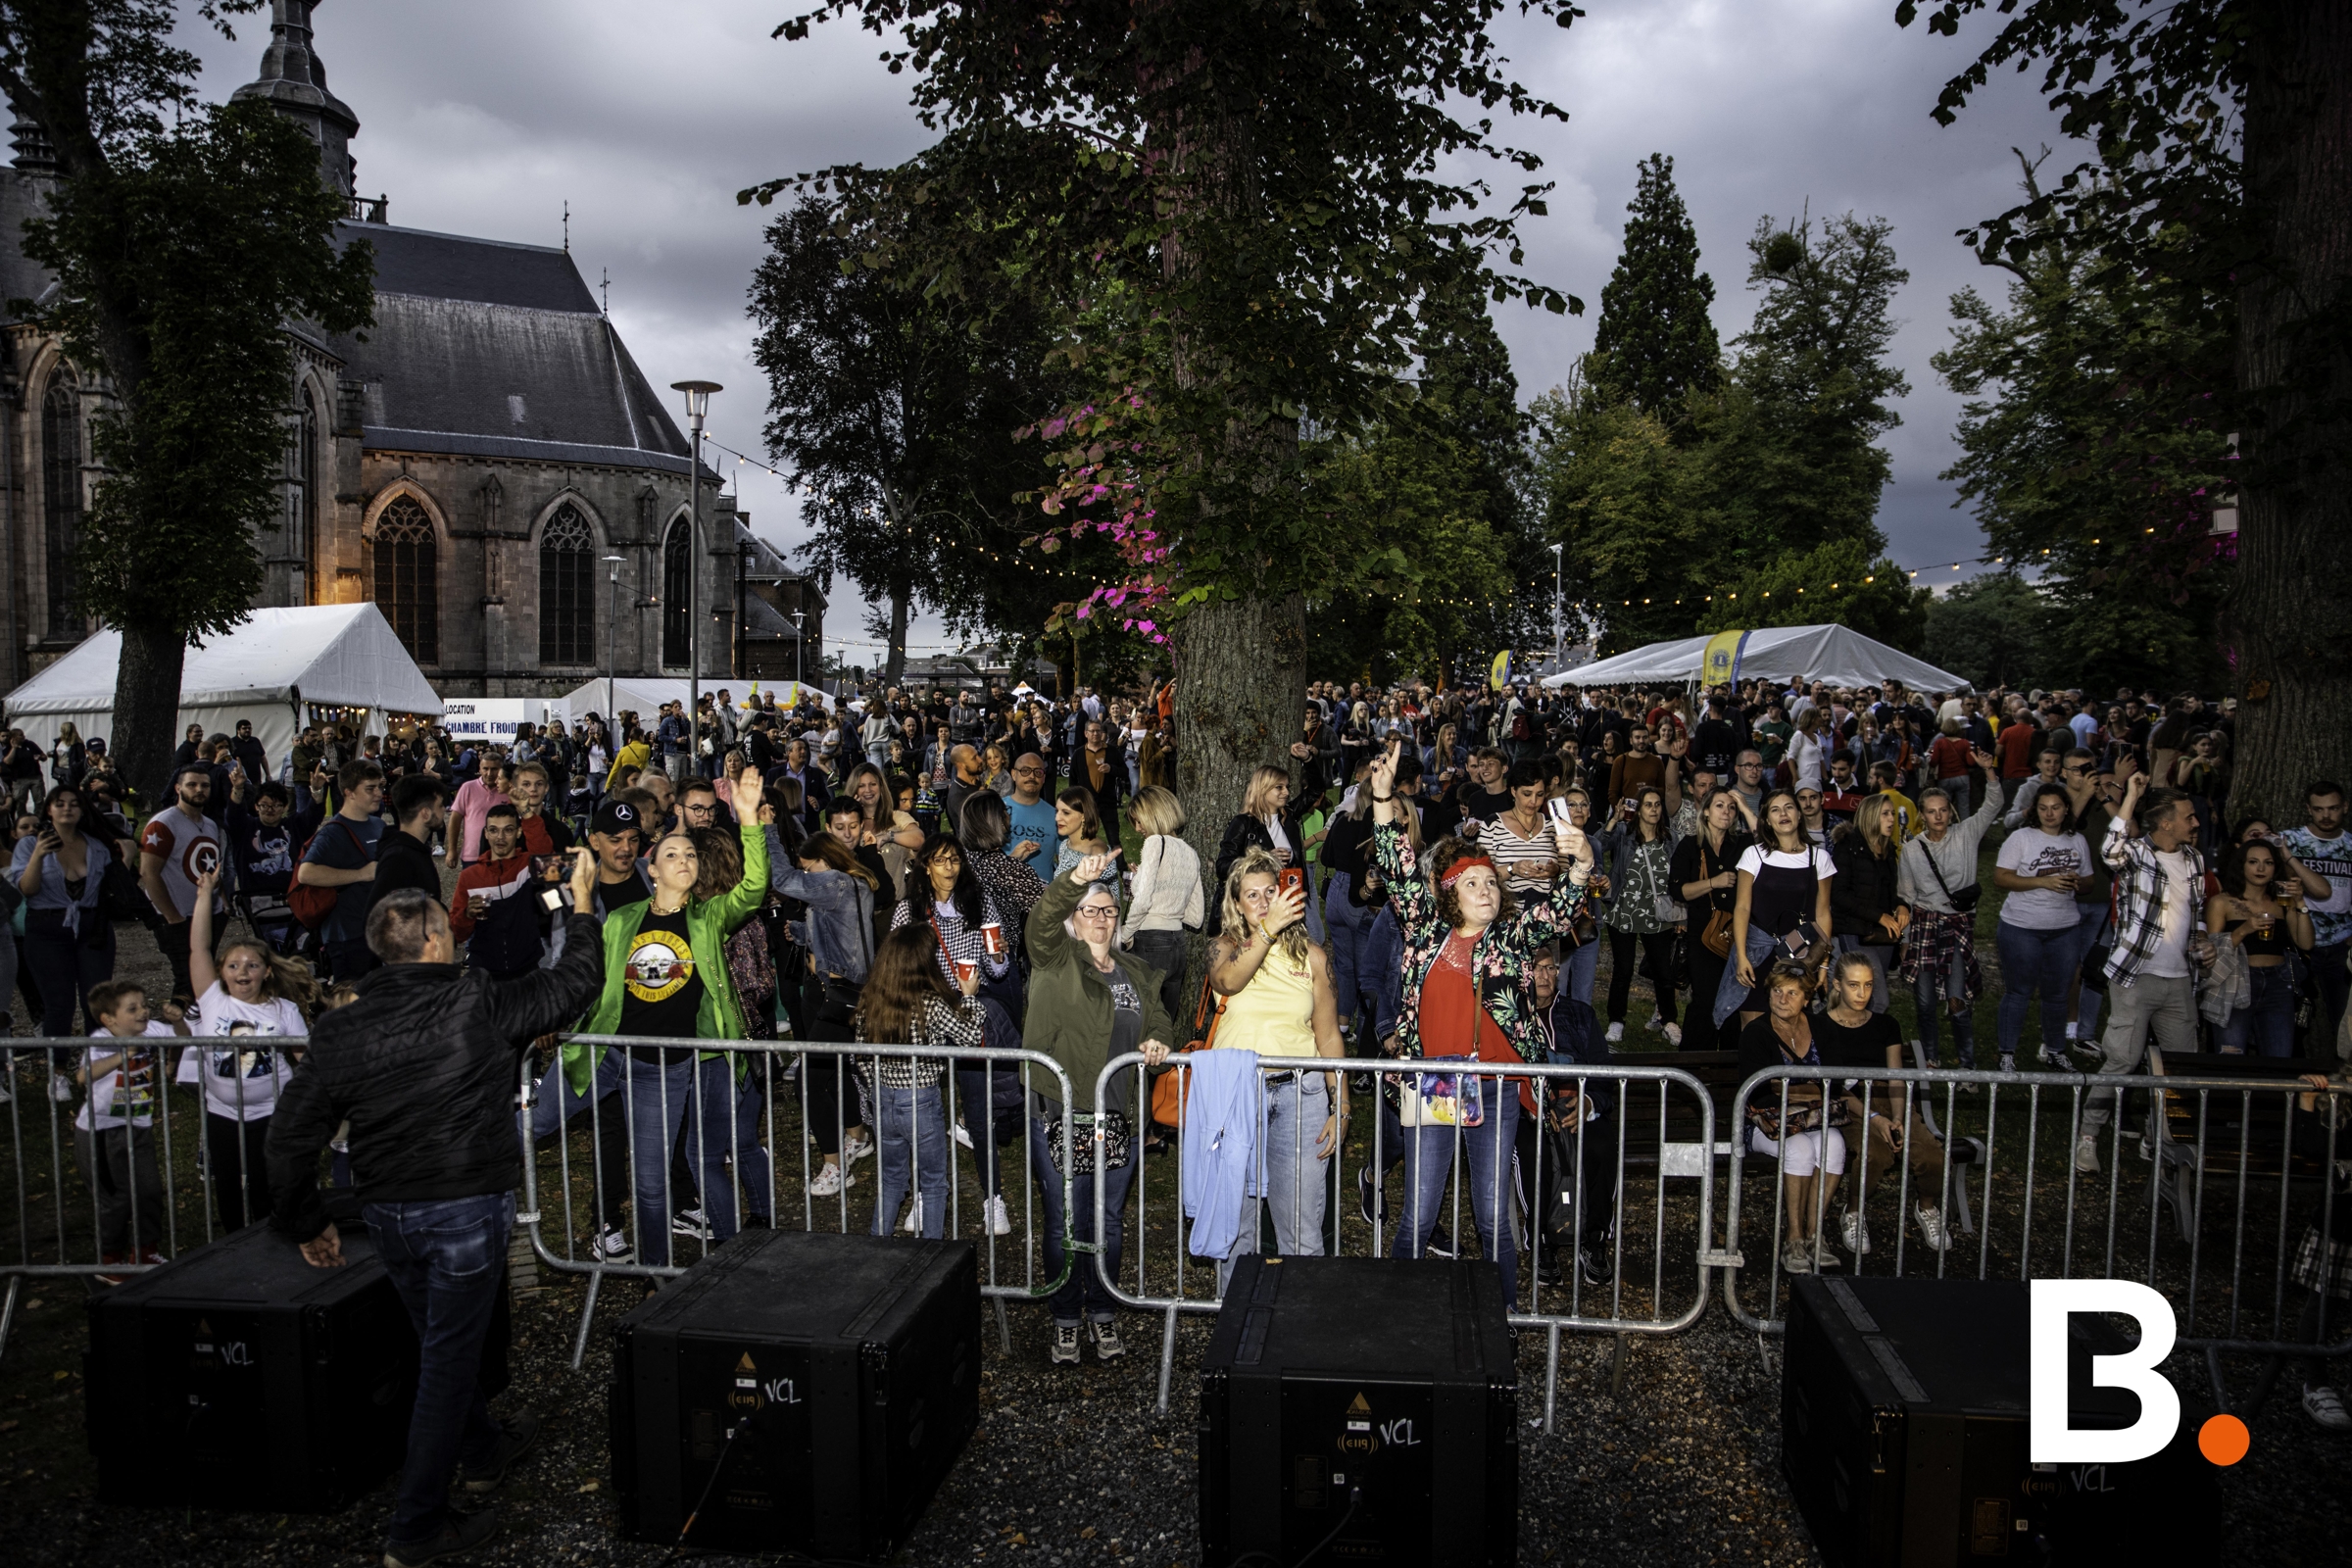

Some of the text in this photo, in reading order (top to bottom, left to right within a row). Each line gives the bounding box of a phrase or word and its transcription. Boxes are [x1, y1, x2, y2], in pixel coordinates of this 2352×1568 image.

[445, 705, 475, 714] LOCATION
[445, 721, 523, 734] CHAMBRE FROID
[1009, 824, 1045, 838] OSS
[2303, 858, 2352, 875] FESTIVAL
[220, 1341, 255, 1366] VCL
[764, 1378, 802, 1403] VCL
[1379, 1417, 1421, 1446] VCL
[2070, 1464, 2115, 1494] VCL
